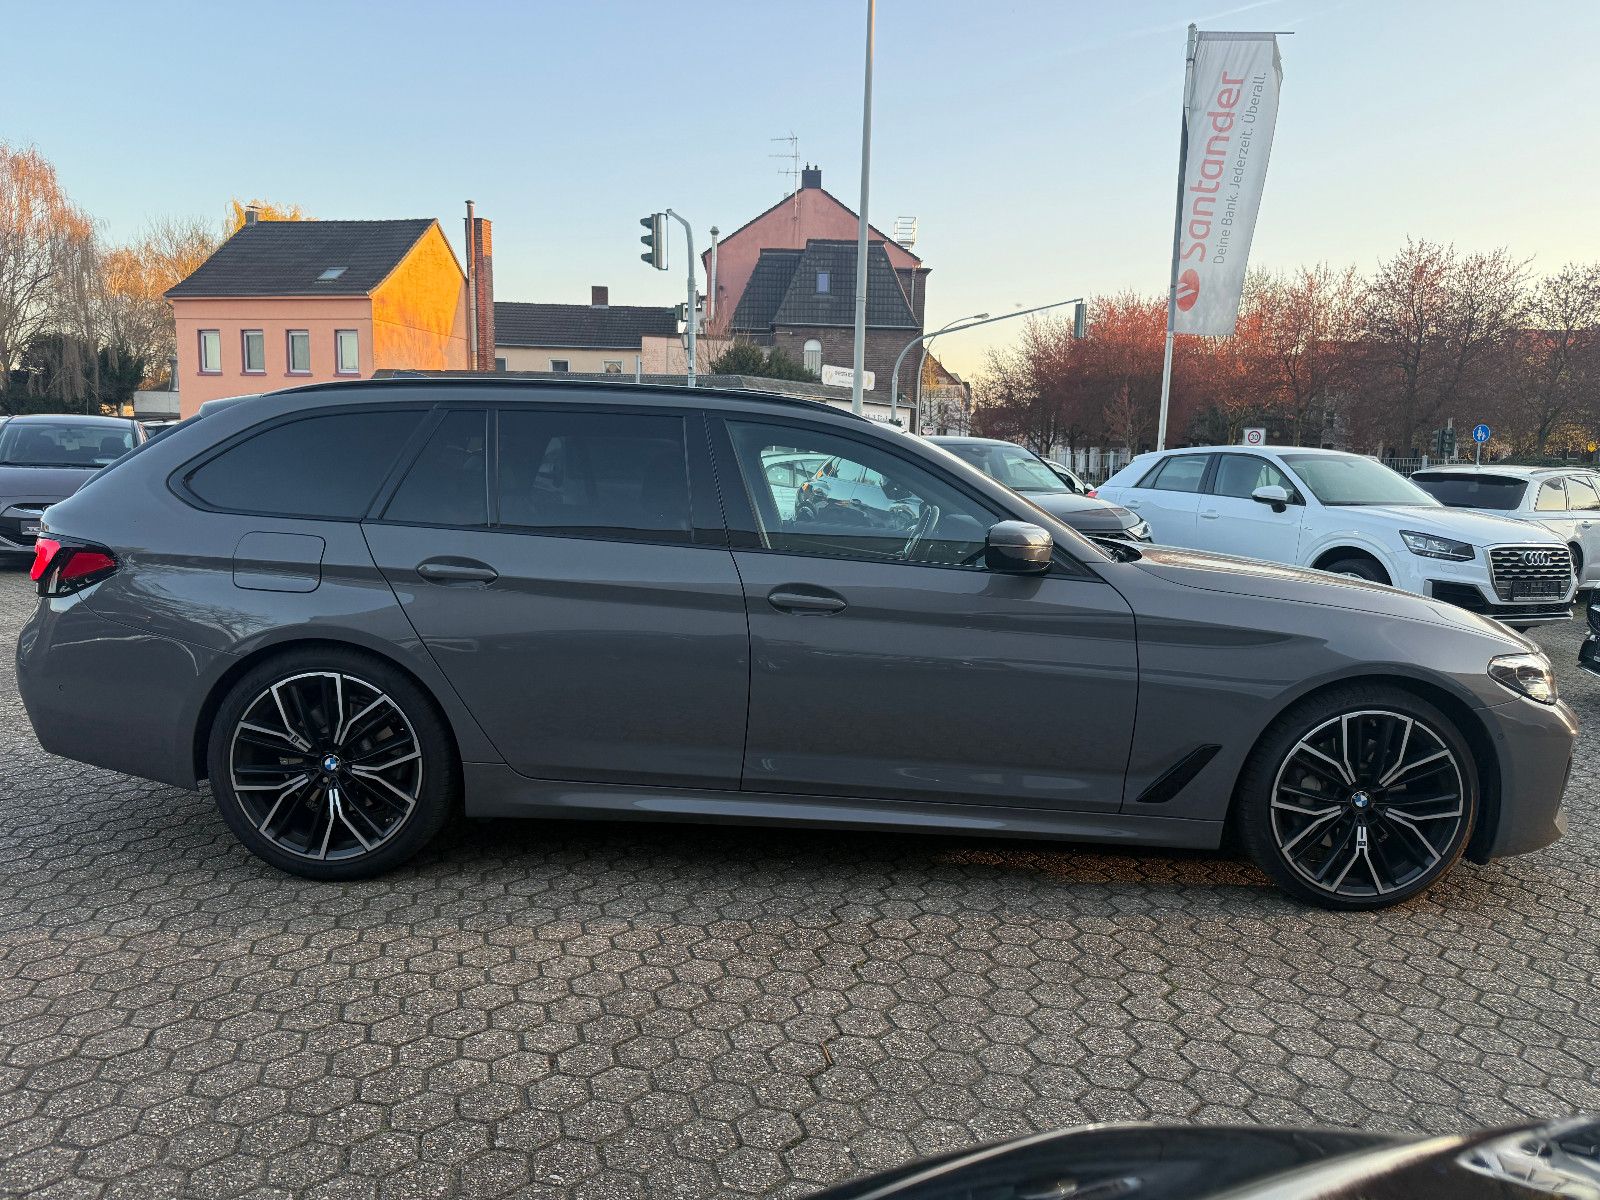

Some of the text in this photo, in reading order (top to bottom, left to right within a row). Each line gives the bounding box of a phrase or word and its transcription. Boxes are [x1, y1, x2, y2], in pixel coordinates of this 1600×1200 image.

[1180, 71, 1244, 262] Santander
[1213, 72, 1266, 264] Deine Bank. Jederzeit. Überall.
